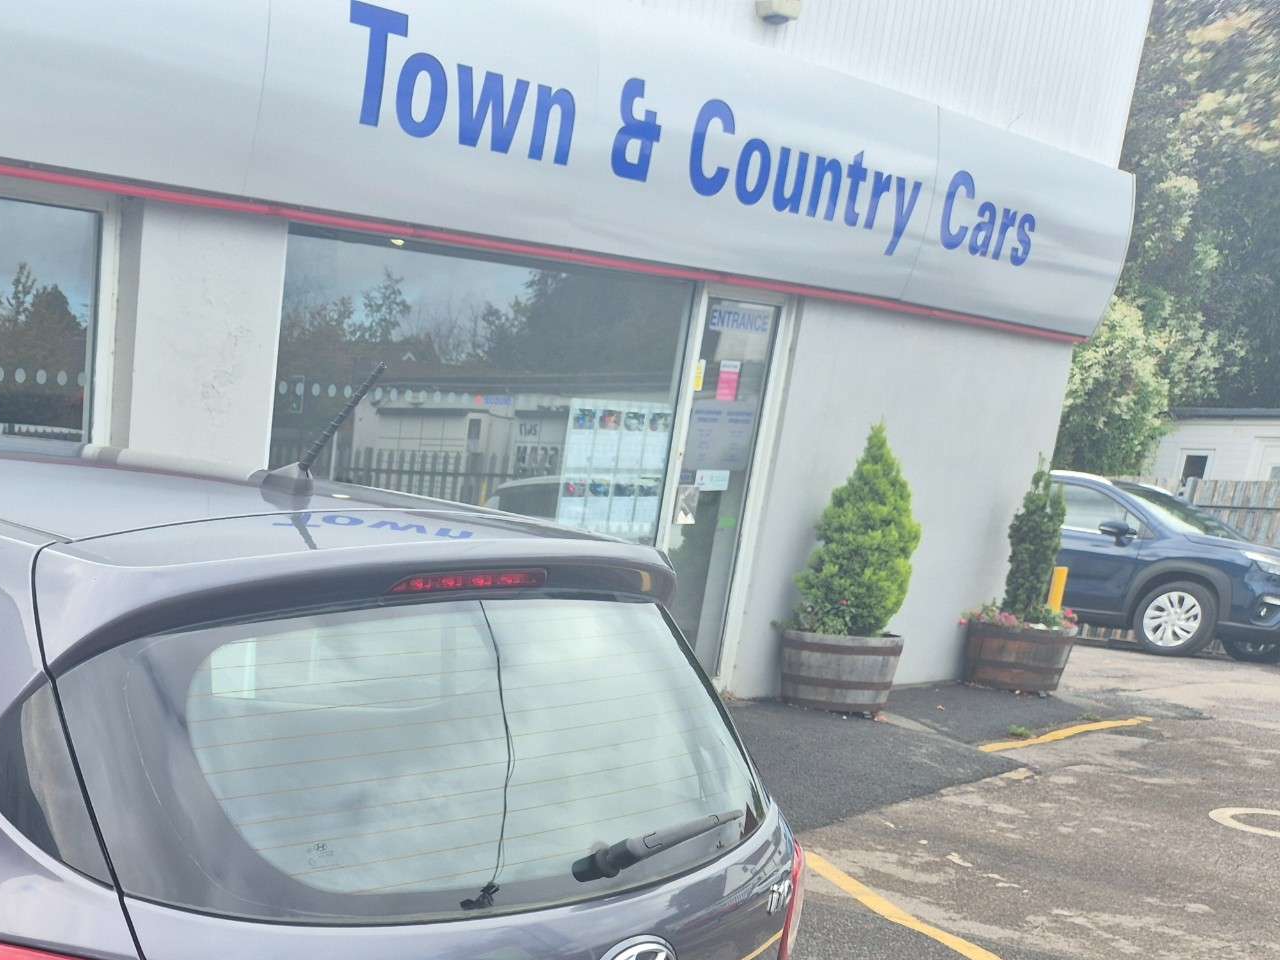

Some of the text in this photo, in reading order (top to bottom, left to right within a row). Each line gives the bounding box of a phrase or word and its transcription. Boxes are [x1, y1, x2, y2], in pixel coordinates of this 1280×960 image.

[349, 0, 1037, 268] Town & Country Cars
[709, 308, 770, 333] ENTRANCE
